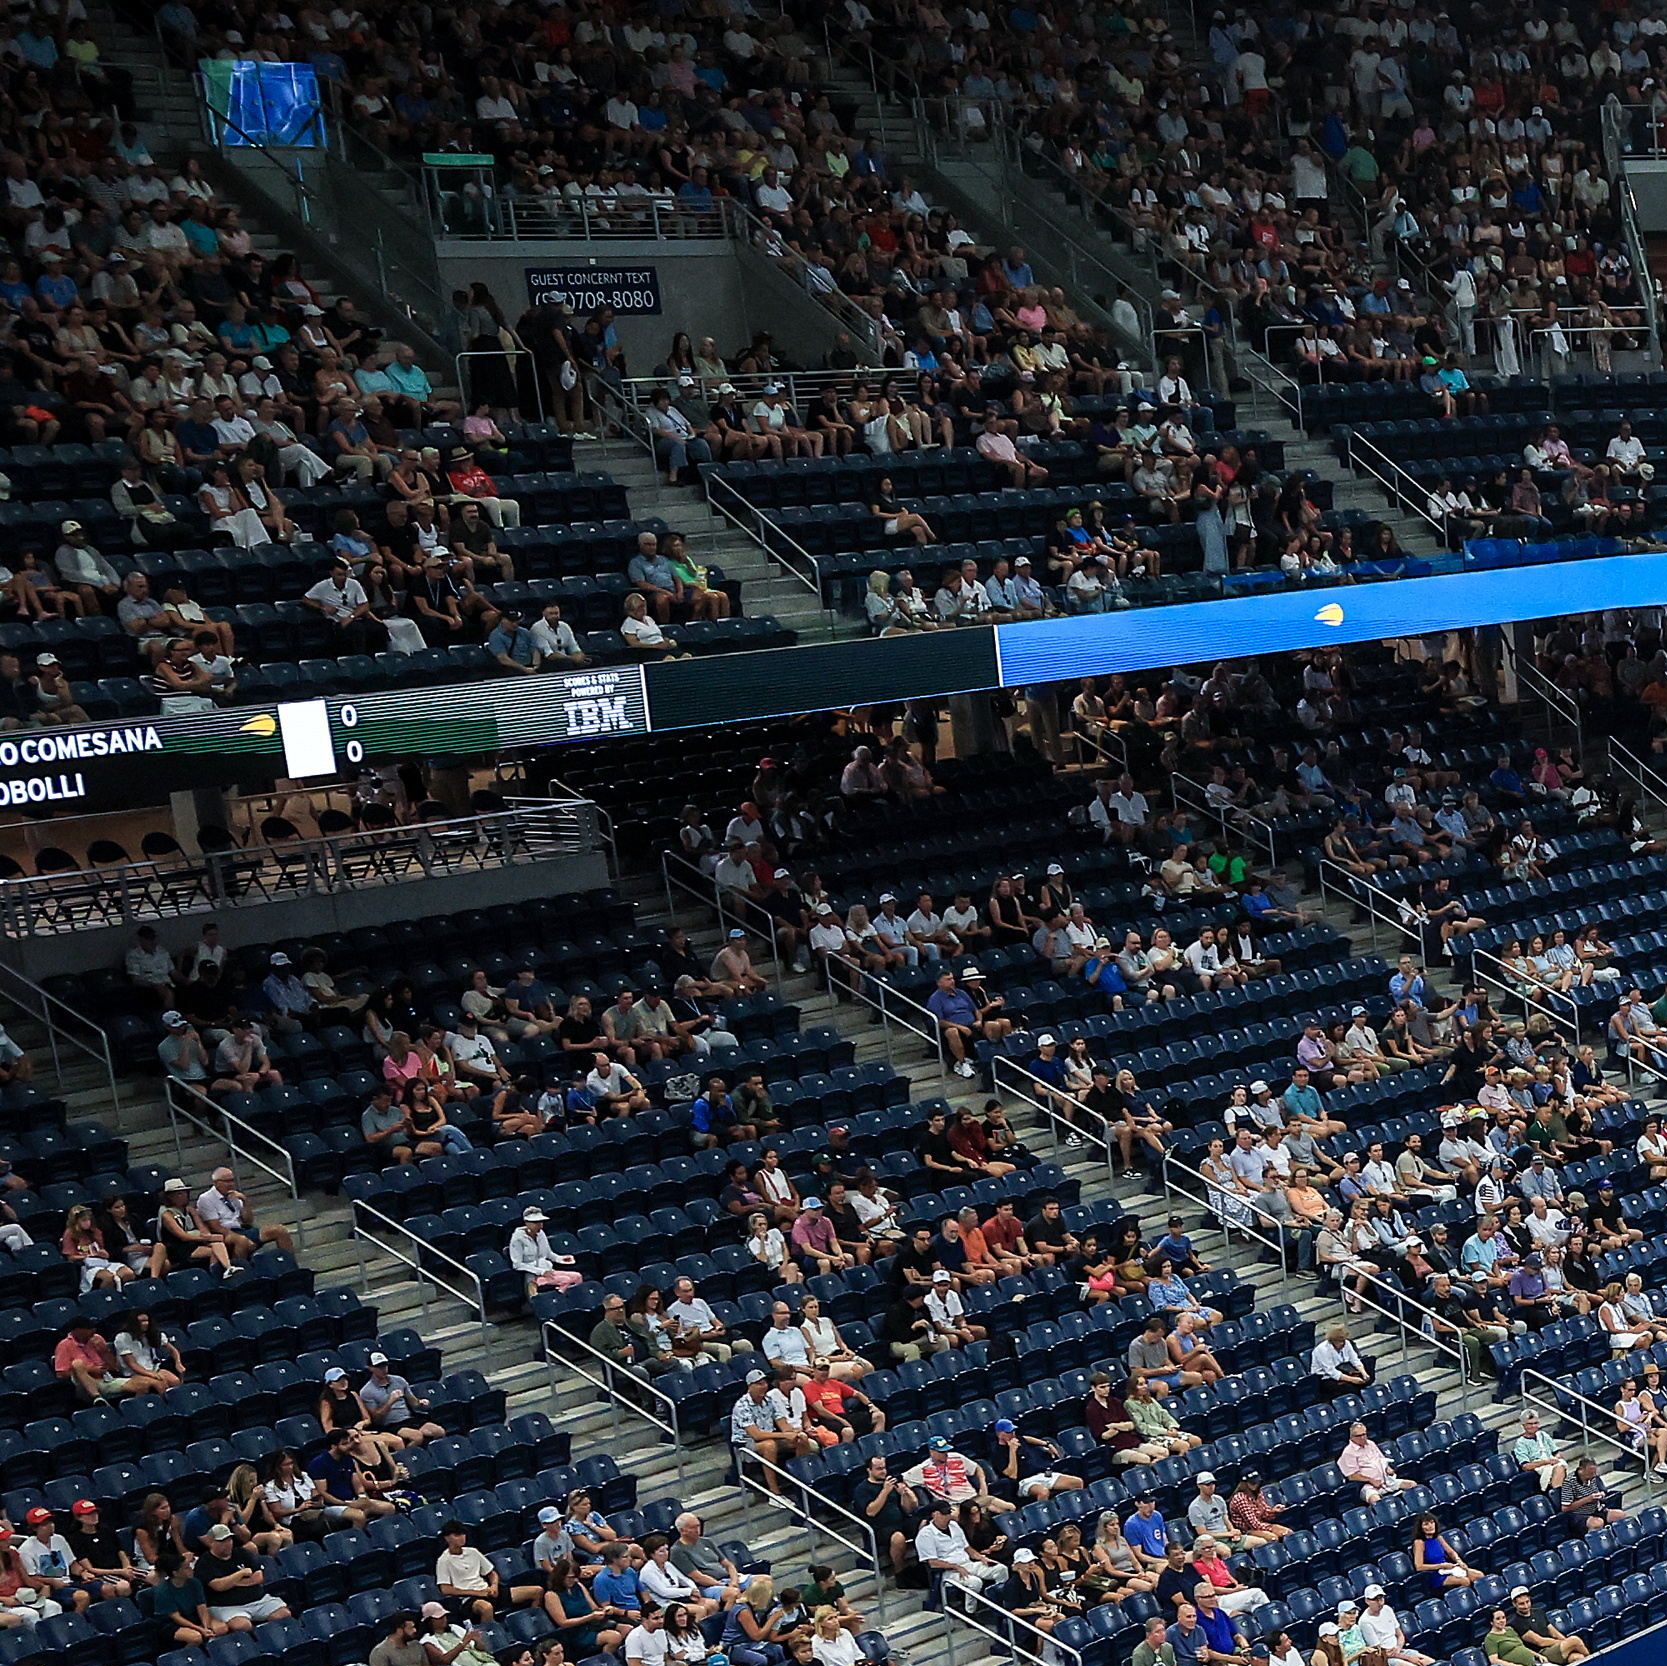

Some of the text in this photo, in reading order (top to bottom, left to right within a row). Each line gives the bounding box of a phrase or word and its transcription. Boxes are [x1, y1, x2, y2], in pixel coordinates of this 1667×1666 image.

[531, 272, 651, 286] GUEST CONCERN? TEXT
[535, 290, 654, 309] (7)708-8080
[604, 684, 615, 694] BY
[340, 704, 358, 728] 0
[20, 726, 163, 764] COMESANA
[346, 740, 364, 763] 0
